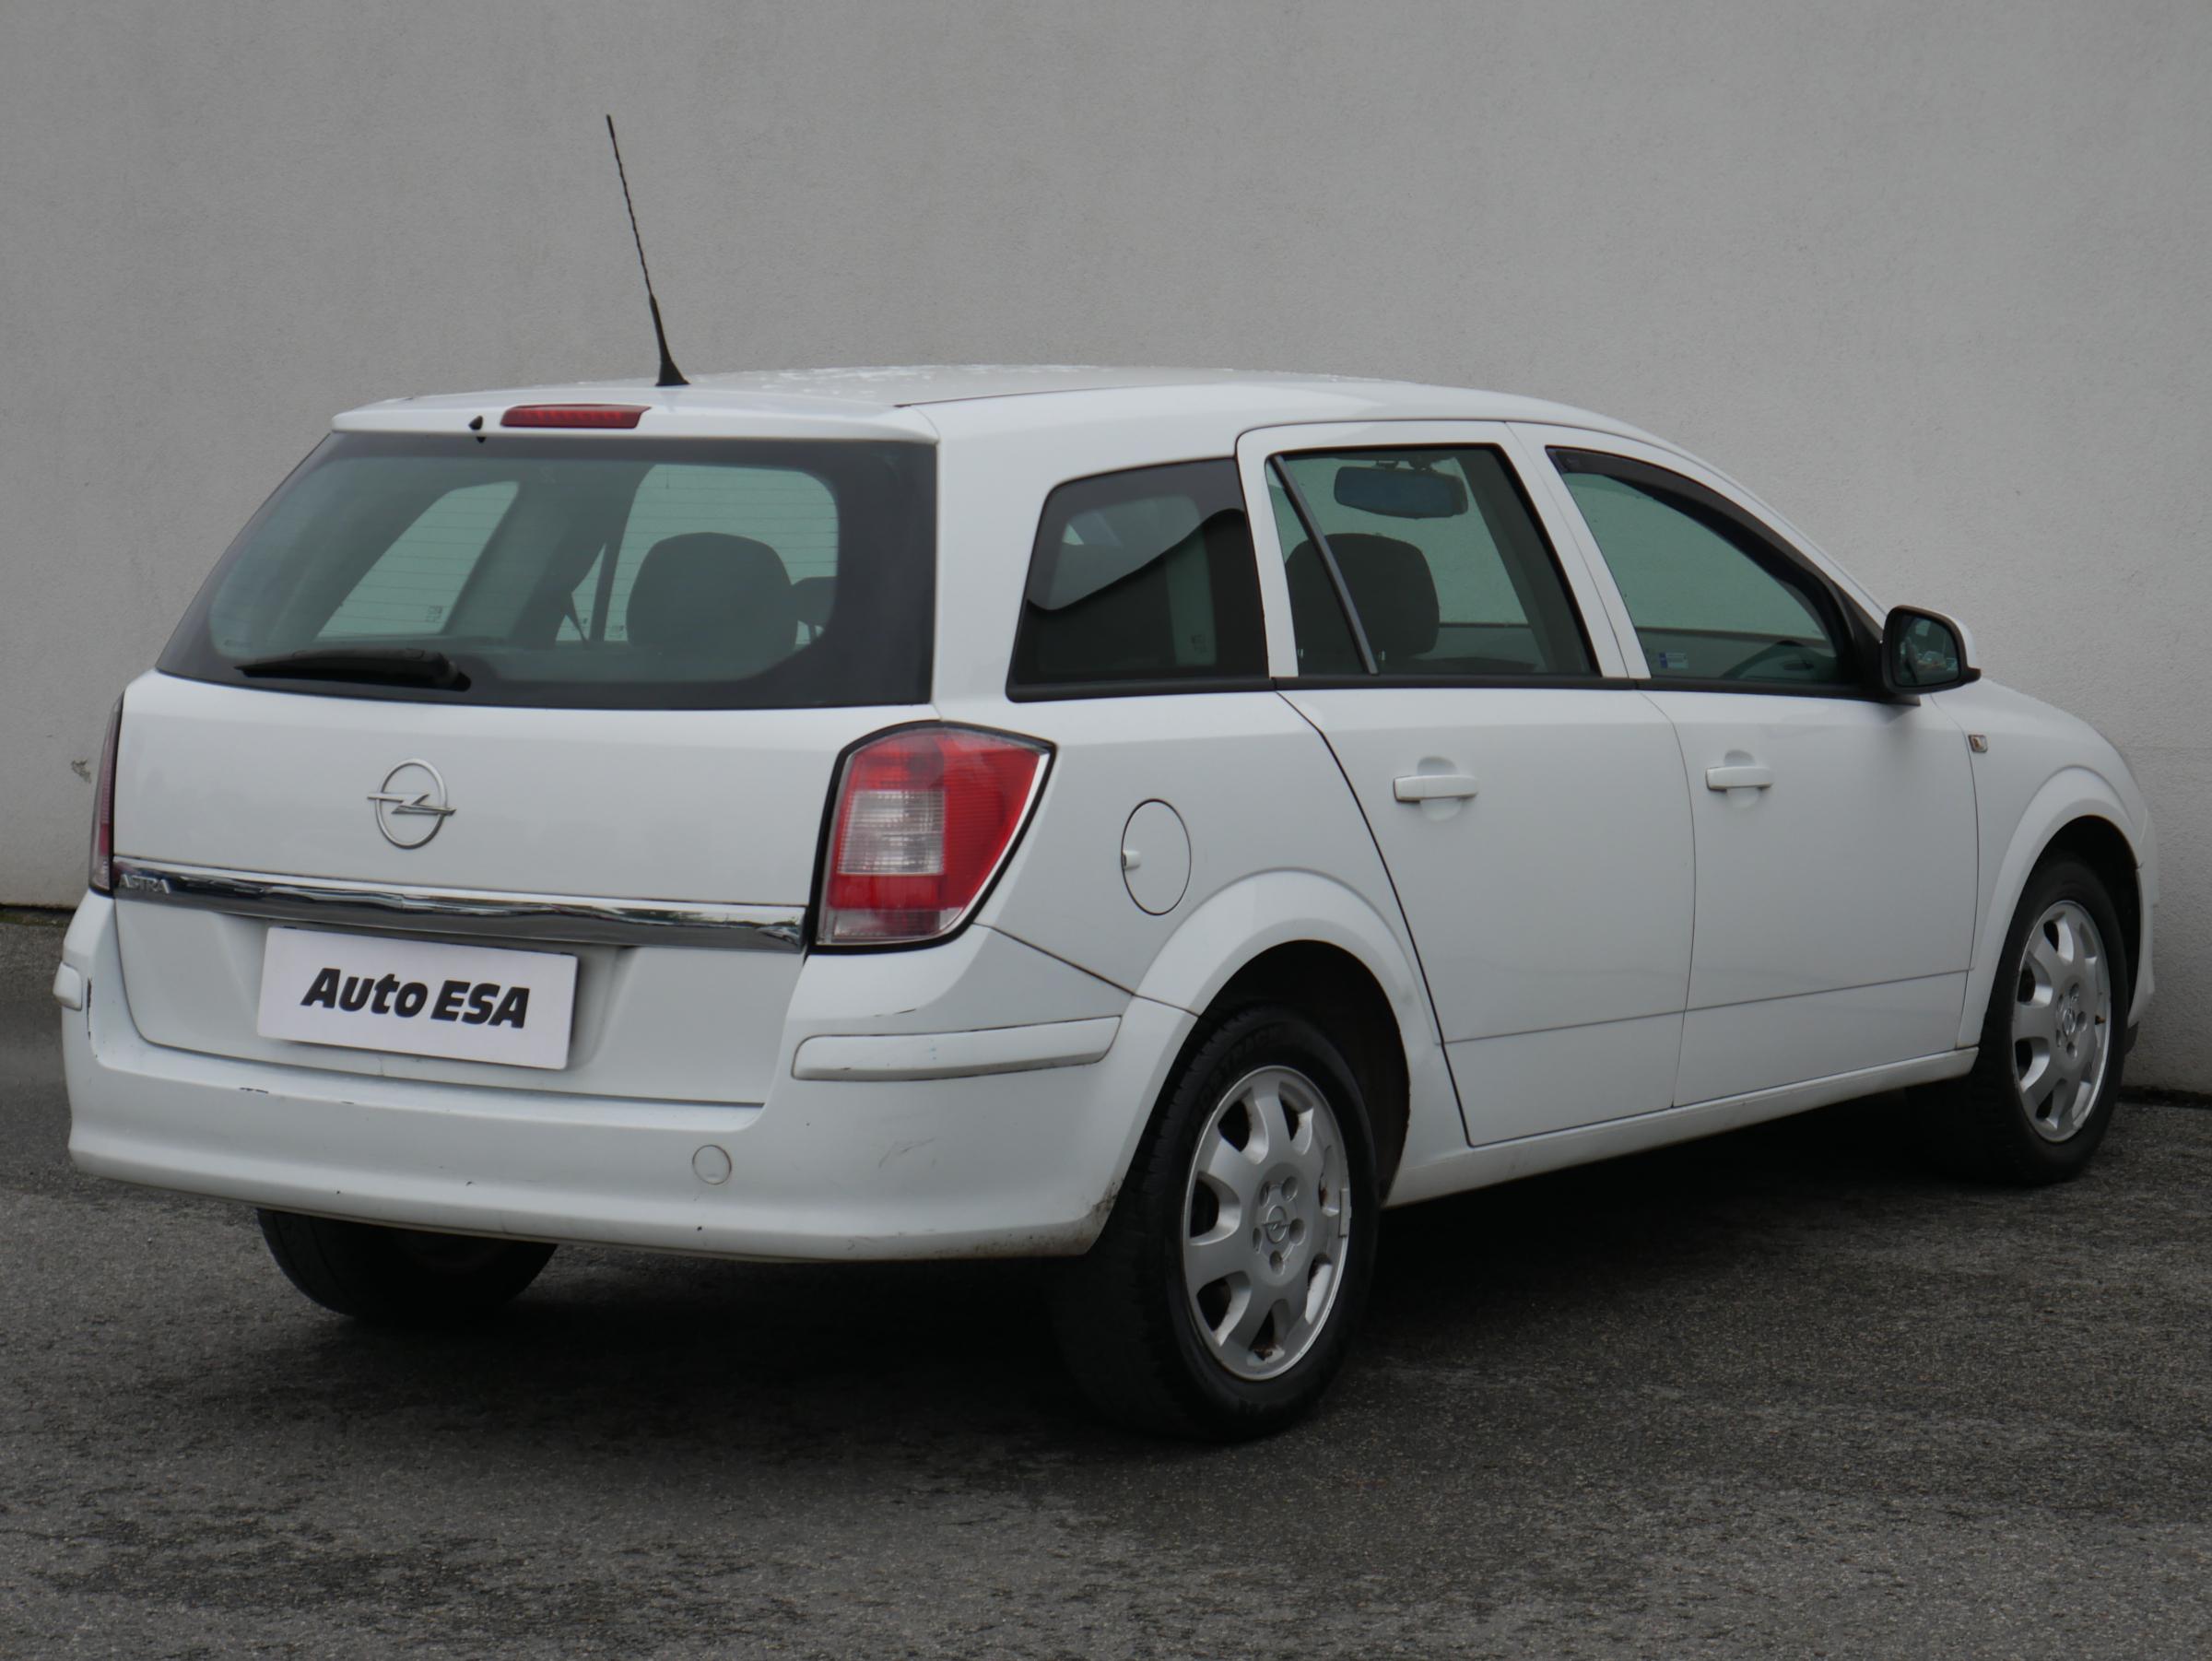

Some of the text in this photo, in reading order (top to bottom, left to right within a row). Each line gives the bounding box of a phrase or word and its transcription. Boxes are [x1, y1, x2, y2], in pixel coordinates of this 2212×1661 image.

[119, 874, 171, 894] ASTRA
[300, 967, 530, 1029] Auto ESA
